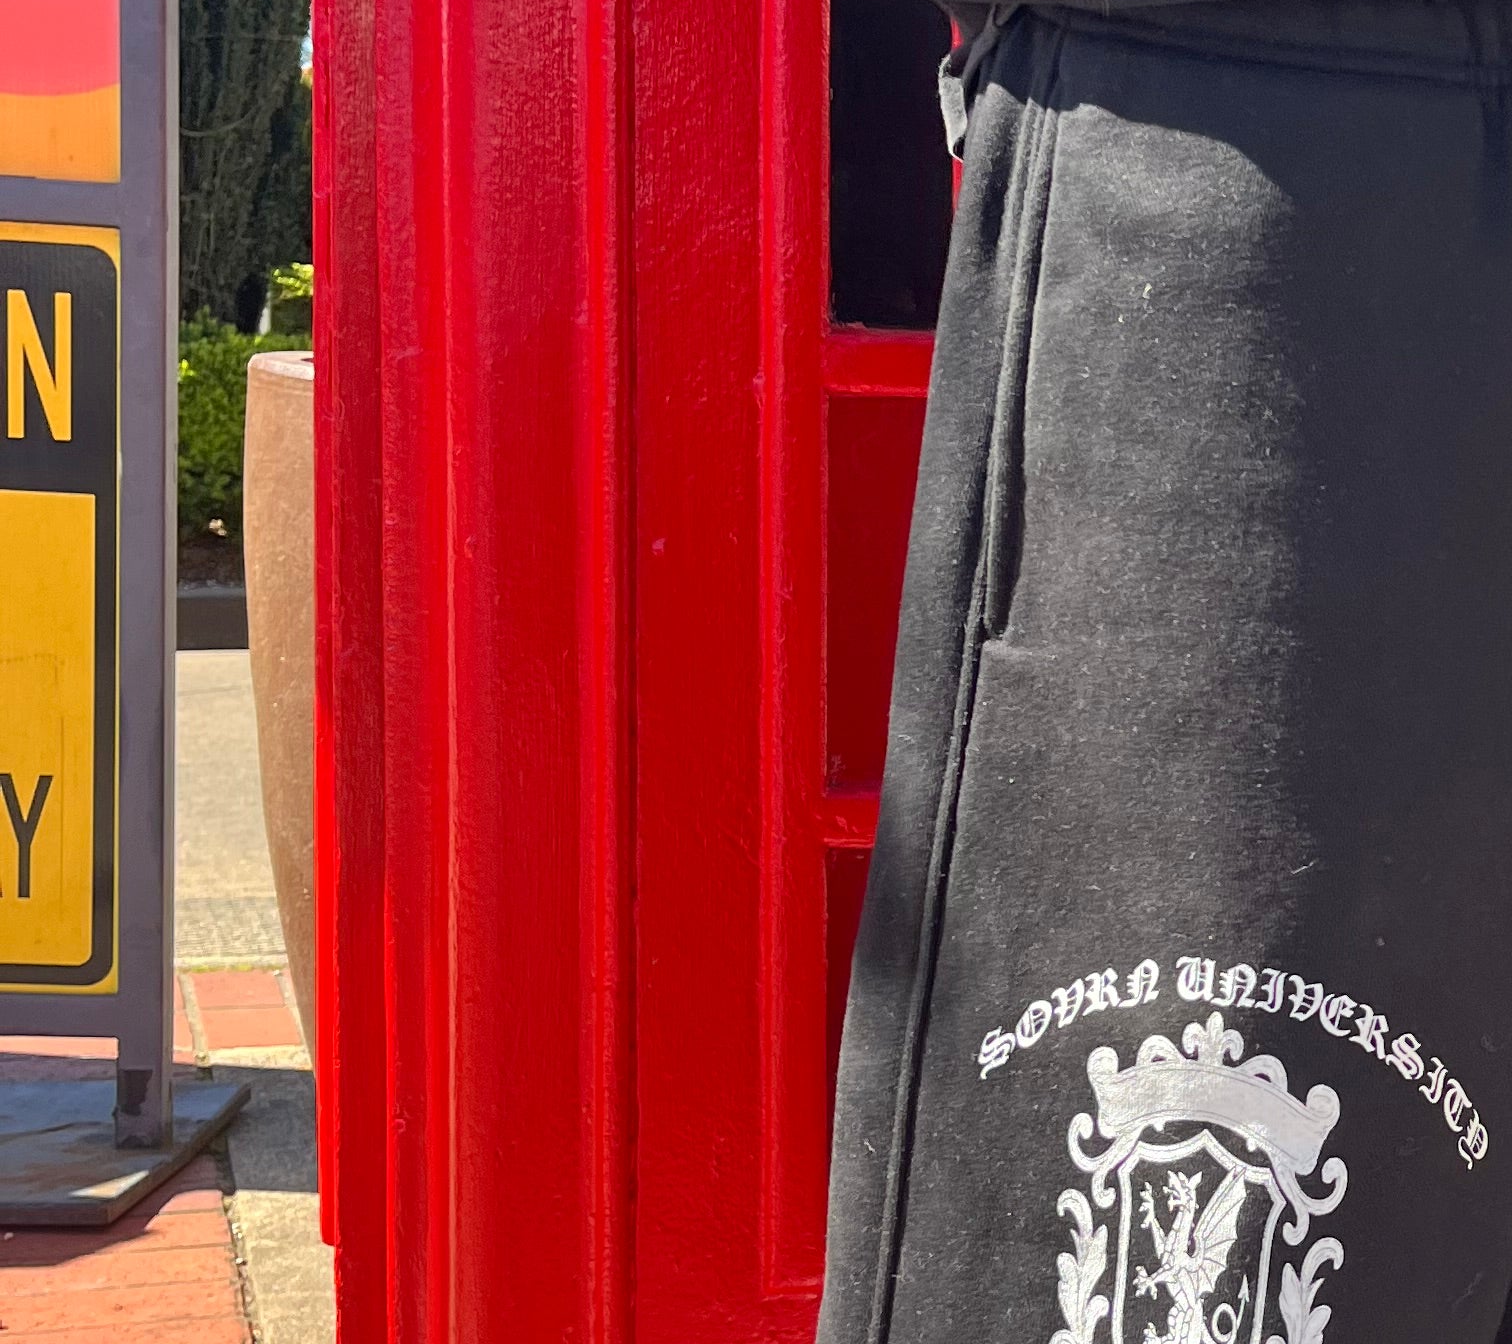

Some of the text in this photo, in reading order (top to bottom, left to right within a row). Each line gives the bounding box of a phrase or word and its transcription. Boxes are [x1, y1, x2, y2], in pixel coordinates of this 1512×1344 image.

[6, 288, 73, 442] N
[977, 955, 1490, 1171] SOVRN UNIVERSITY
